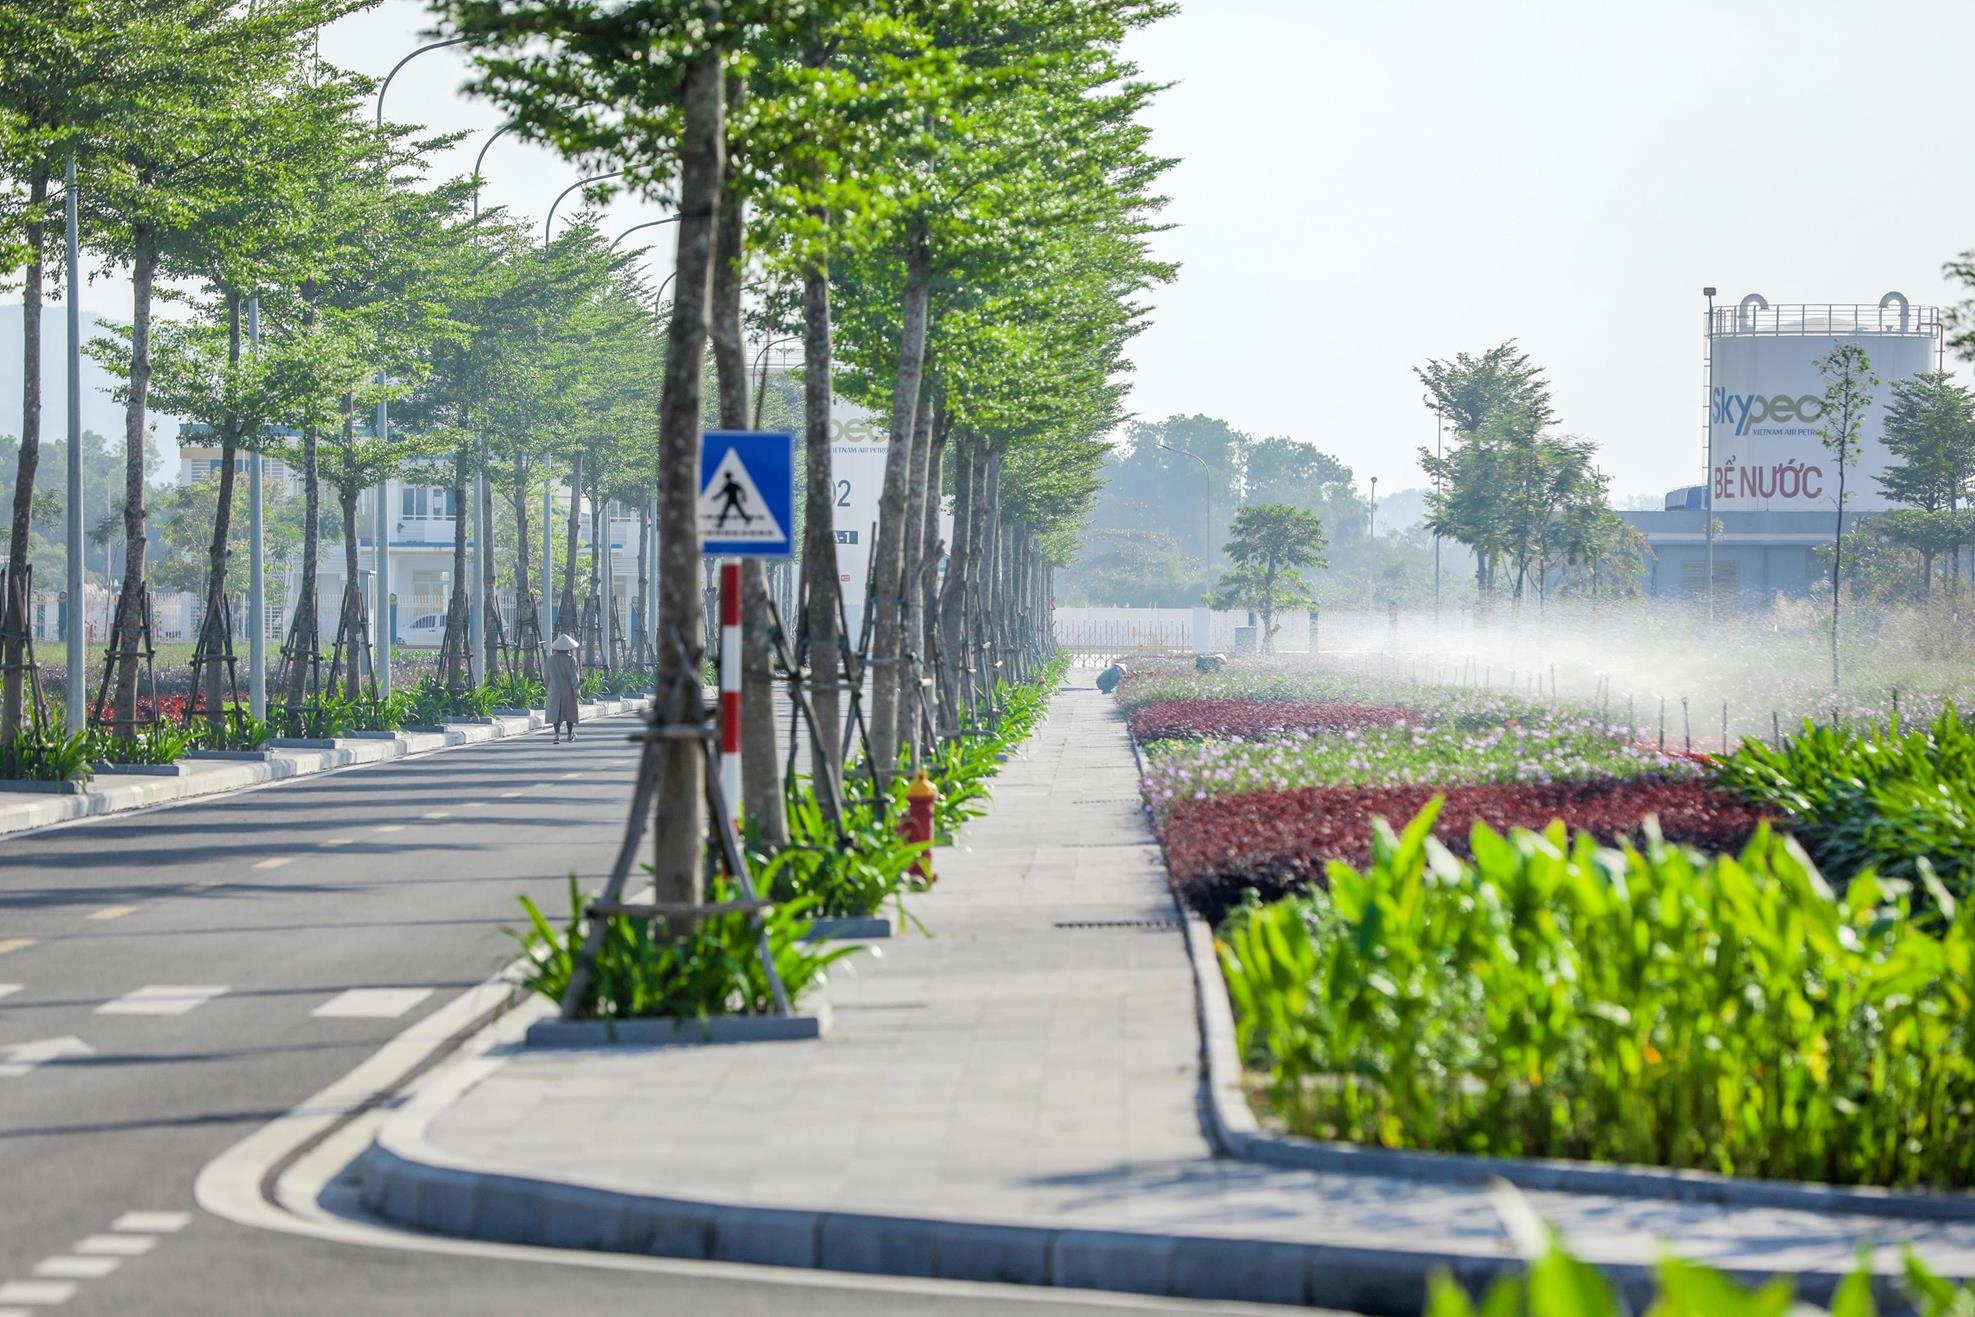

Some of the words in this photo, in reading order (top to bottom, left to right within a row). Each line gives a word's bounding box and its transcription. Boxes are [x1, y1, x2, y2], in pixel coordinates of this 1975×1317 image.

[1752, 428, 1783, 436] VIETNAM
[1784, 428, 1797, 436] AIR
[1798, 428, 1815, 436] PETR
[1714, 454, 1737, 499] BỂ
[1739, 458, 1823, 499] NƯỚC
[832, 479, 851, 507] 2
